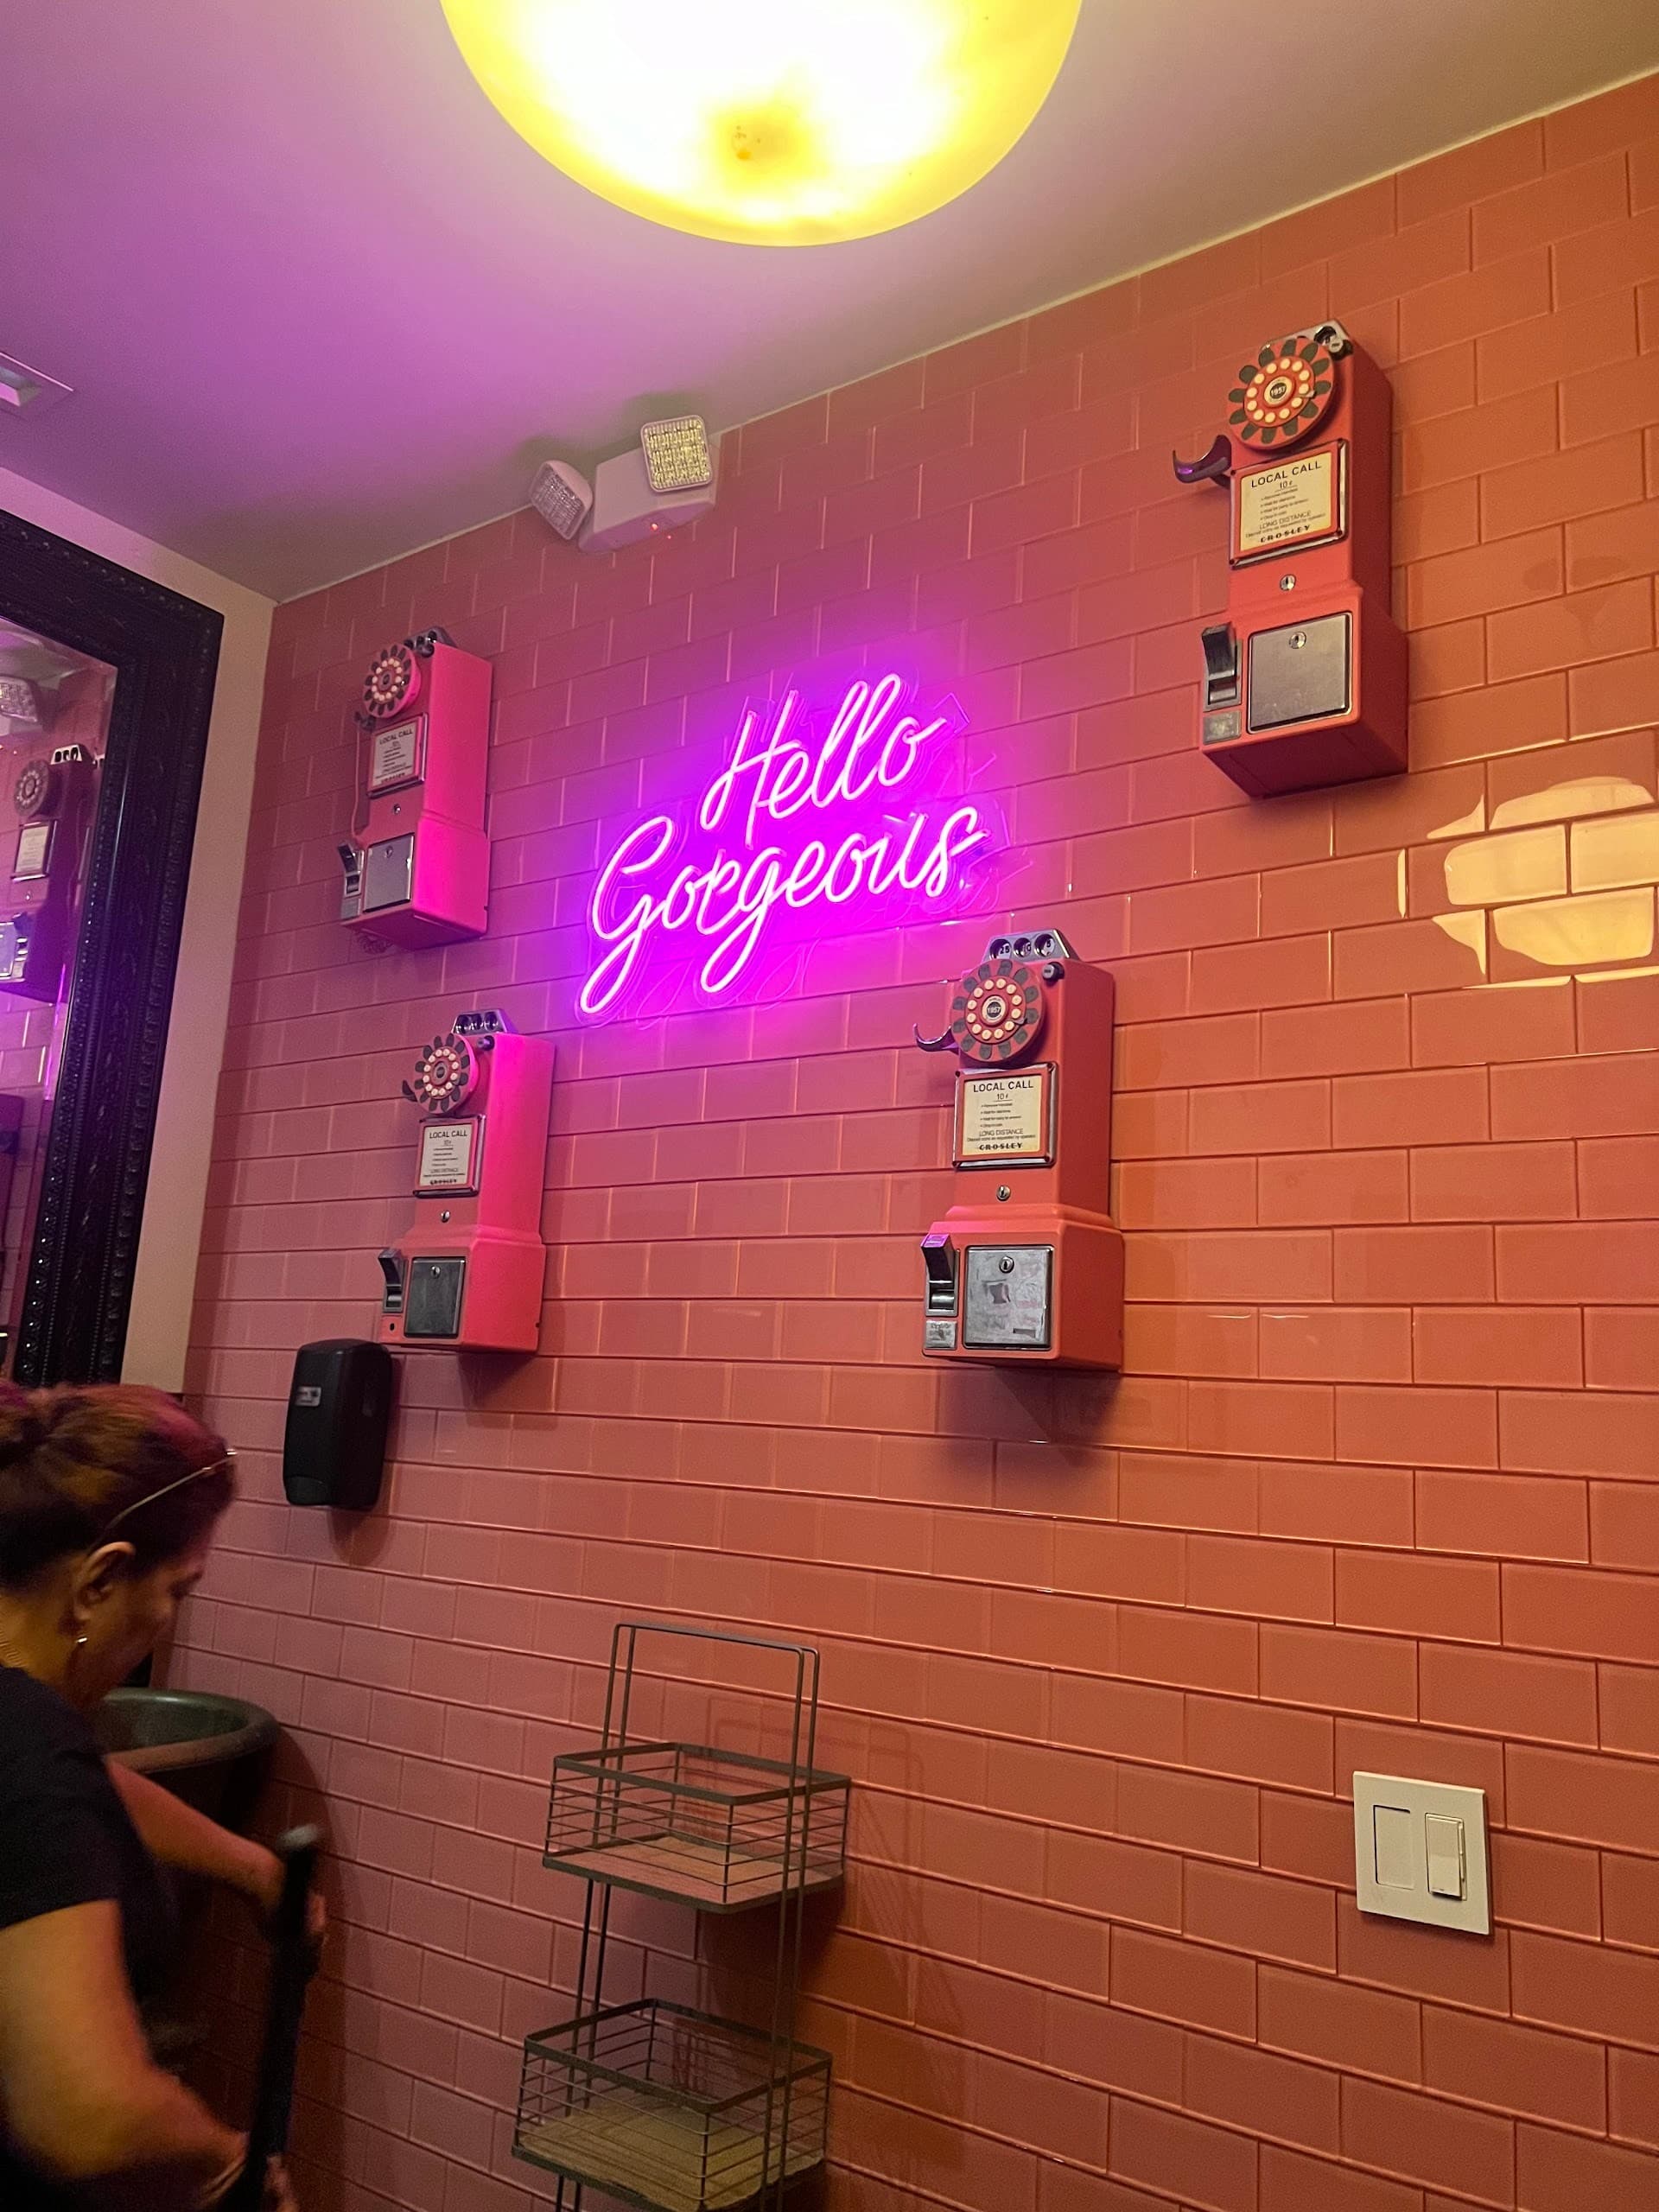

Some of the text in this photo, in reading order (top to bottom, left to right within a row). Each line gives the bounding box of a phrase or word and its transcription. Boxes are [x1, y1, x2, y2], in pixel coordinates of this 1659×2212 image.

[1251, 461, 1322, 488] LOCAL CALL
[1259, 519, 1278, 530] LONG
[1279, 510, 1312, 524] DISTANCE
[1260, 524, 1311, 543] CROSLEY
[398, 728, 413, 737] CALL
[700, 673, 948, 849] Hello
[580, 806, 989, 1014] Gorgeous
[1000, 945, 1010, 955] 25
[973, 1080, 1033, 1093] LOCAL CALL
[979, 1128, 995, 1137] LONG
[979, 1142, 1023, 1151] CROSLEY
